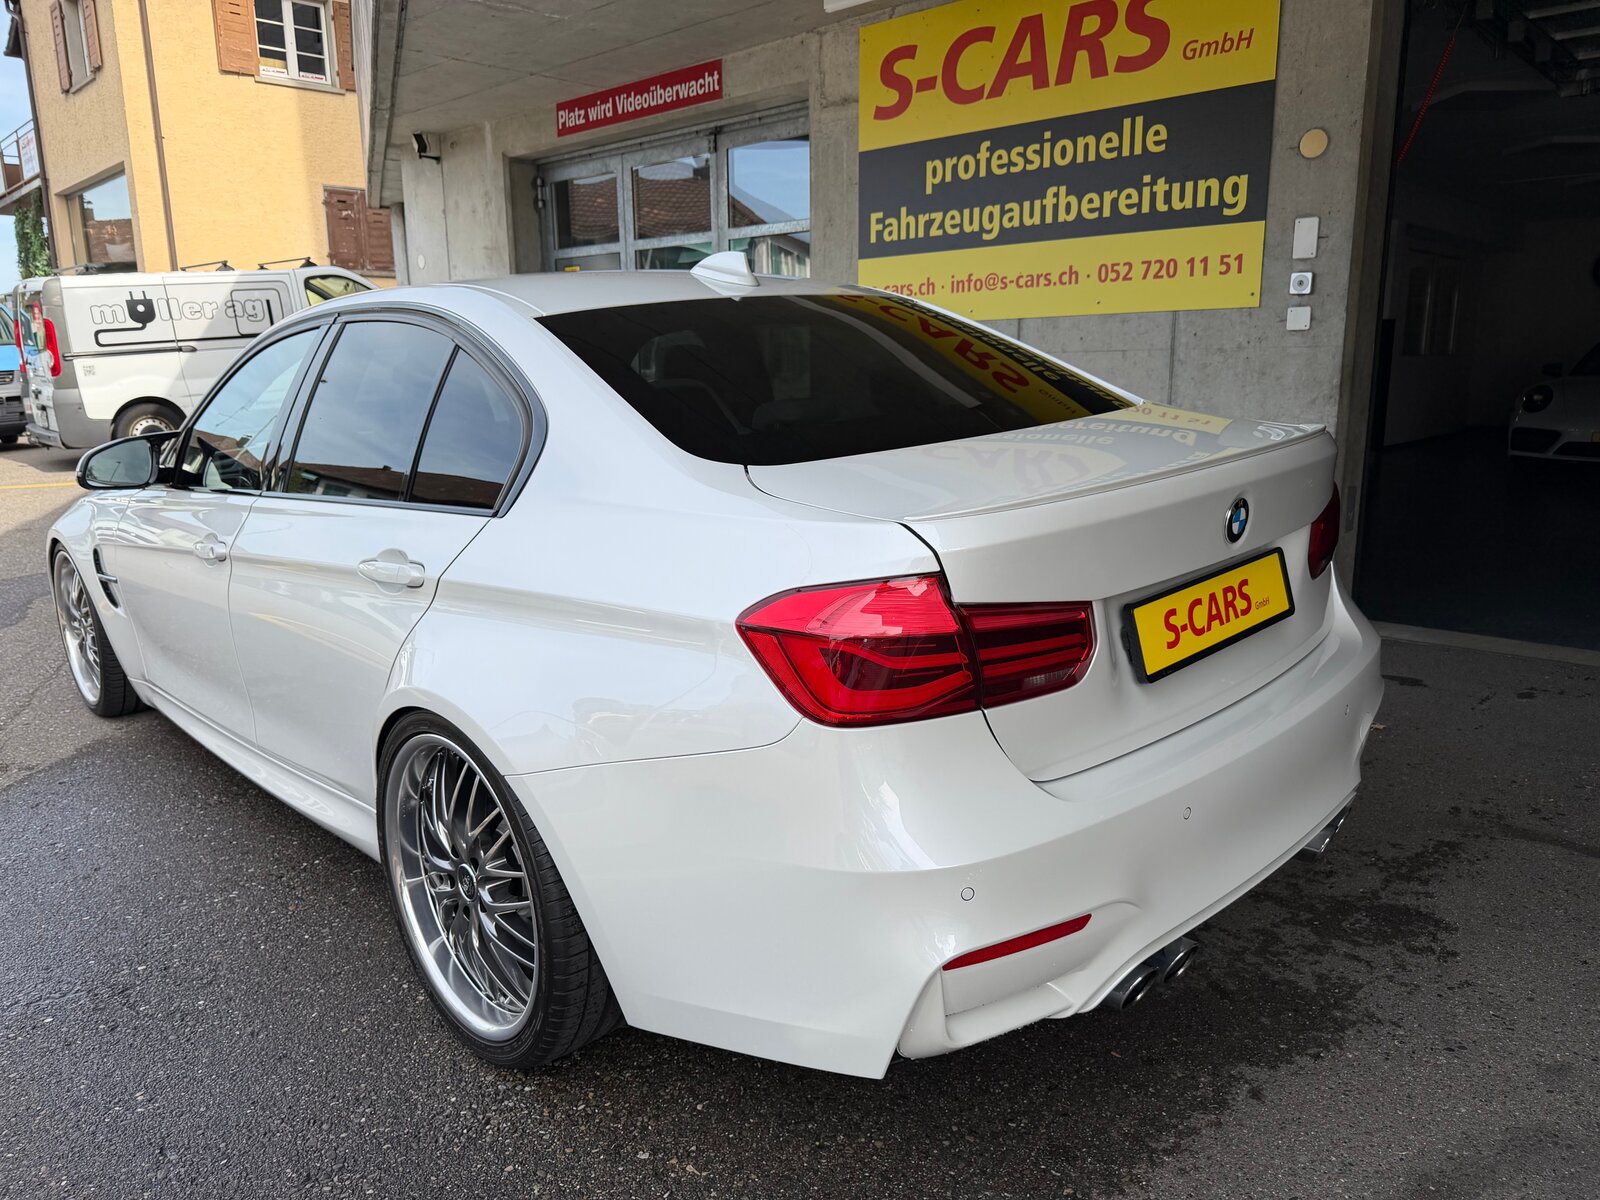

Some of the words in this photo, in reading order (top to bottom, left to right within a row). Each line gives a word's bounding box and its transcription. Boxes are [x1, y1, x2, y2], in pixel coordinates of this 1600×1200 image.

[873, 0, 1171, 121] S-CARS
[1182, 28, 1254, 61] GmbH
[558, 109, 586, 130] Platz
[587, 97, 613, 122] wird
[615, 70, 720, 115] Videoüberwacht
[925, 116, 1168, 195] professionelle
[869, 174, 1249, 244] Fahrzeugaufbereitung
[950, 265, 1079, 294] info@s-cars.ch
[1097, 261, 1133, 284] 052
[1141, 258, 1178, 281] 720
[1186, 256, 1209, 278] 11
[1218, 253, 1244, 276] 51
[1163, 578, 1252, 650] S-CARS
[1254, 597, 1270, 610] GmbH
